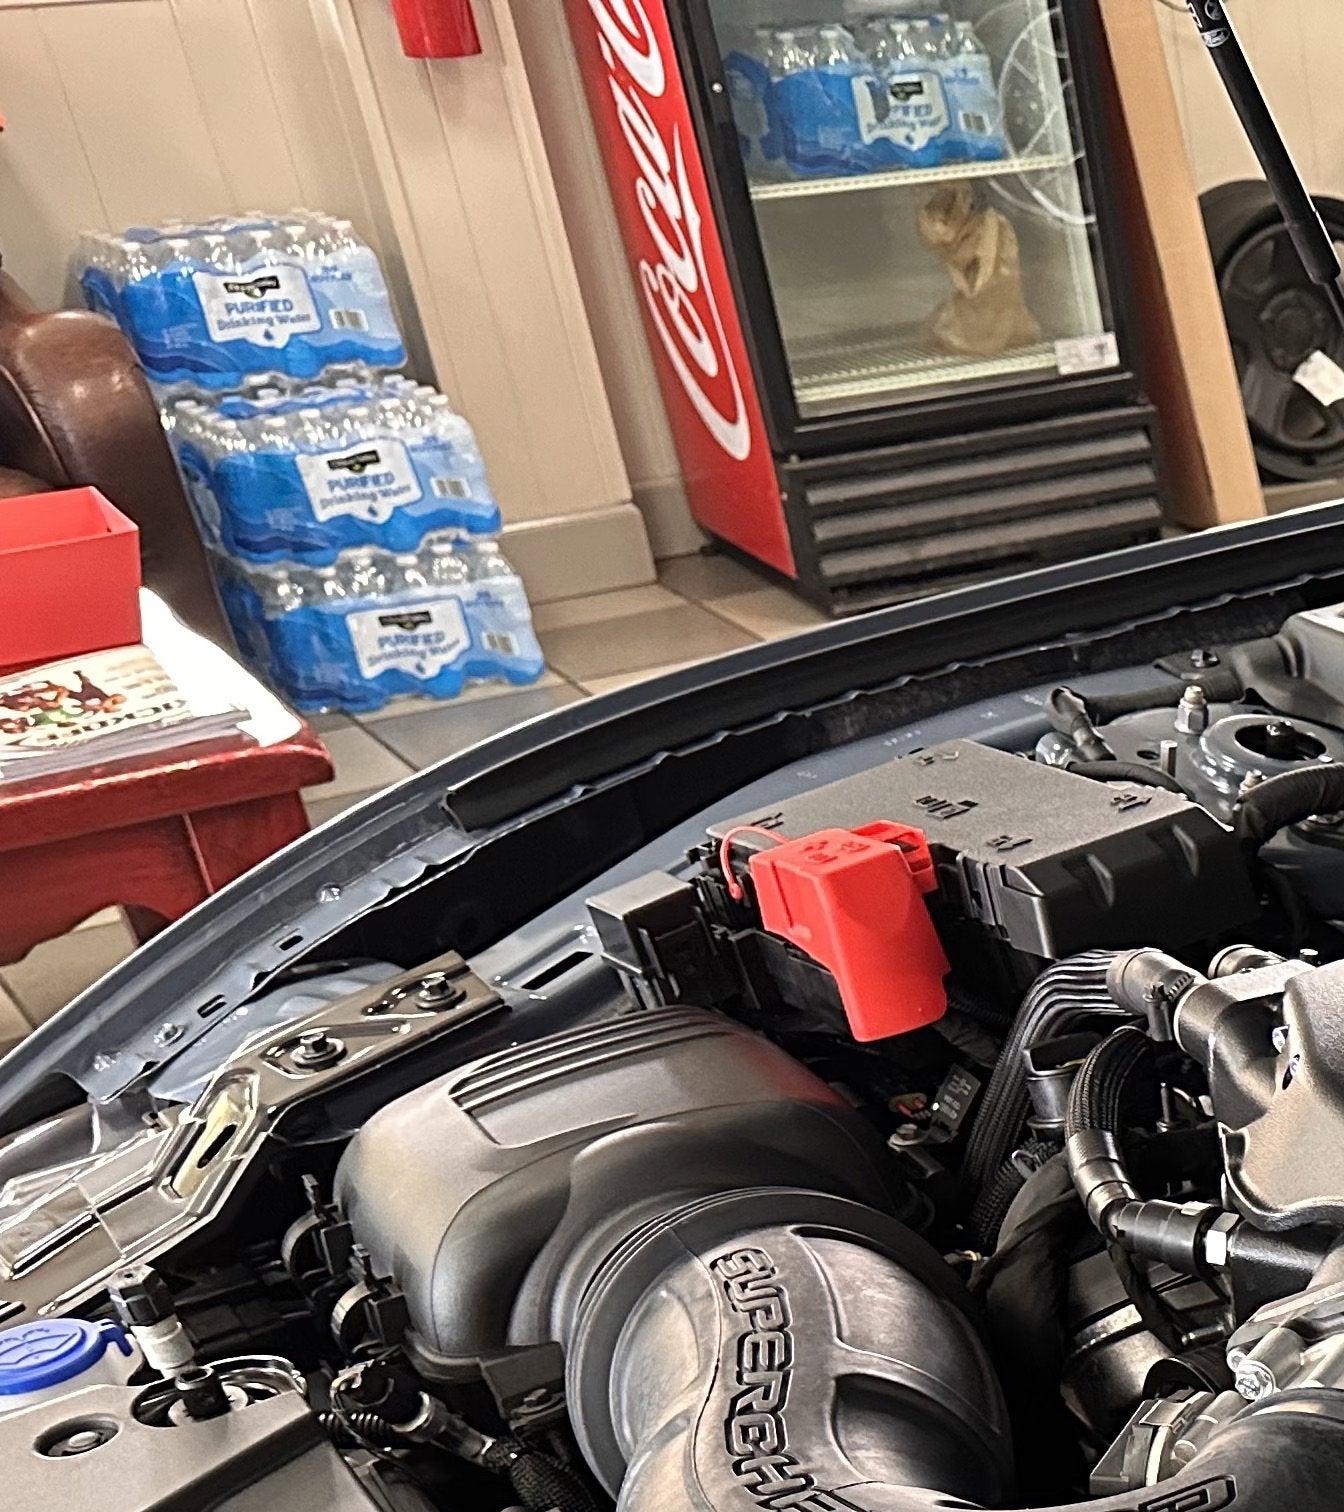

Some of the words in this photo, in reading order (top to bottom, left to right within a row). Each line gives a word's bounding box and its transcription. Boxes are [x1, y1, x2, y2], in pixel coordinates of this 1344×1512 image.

[224, 299, 293, 315] PURIFIED
[216, 315, 275, 332] Drinking
[278, 312, 311, 325] Water
[327, 471, 395, 492] PURIFIED
[377, 630, 446, 648] PURIFIED
